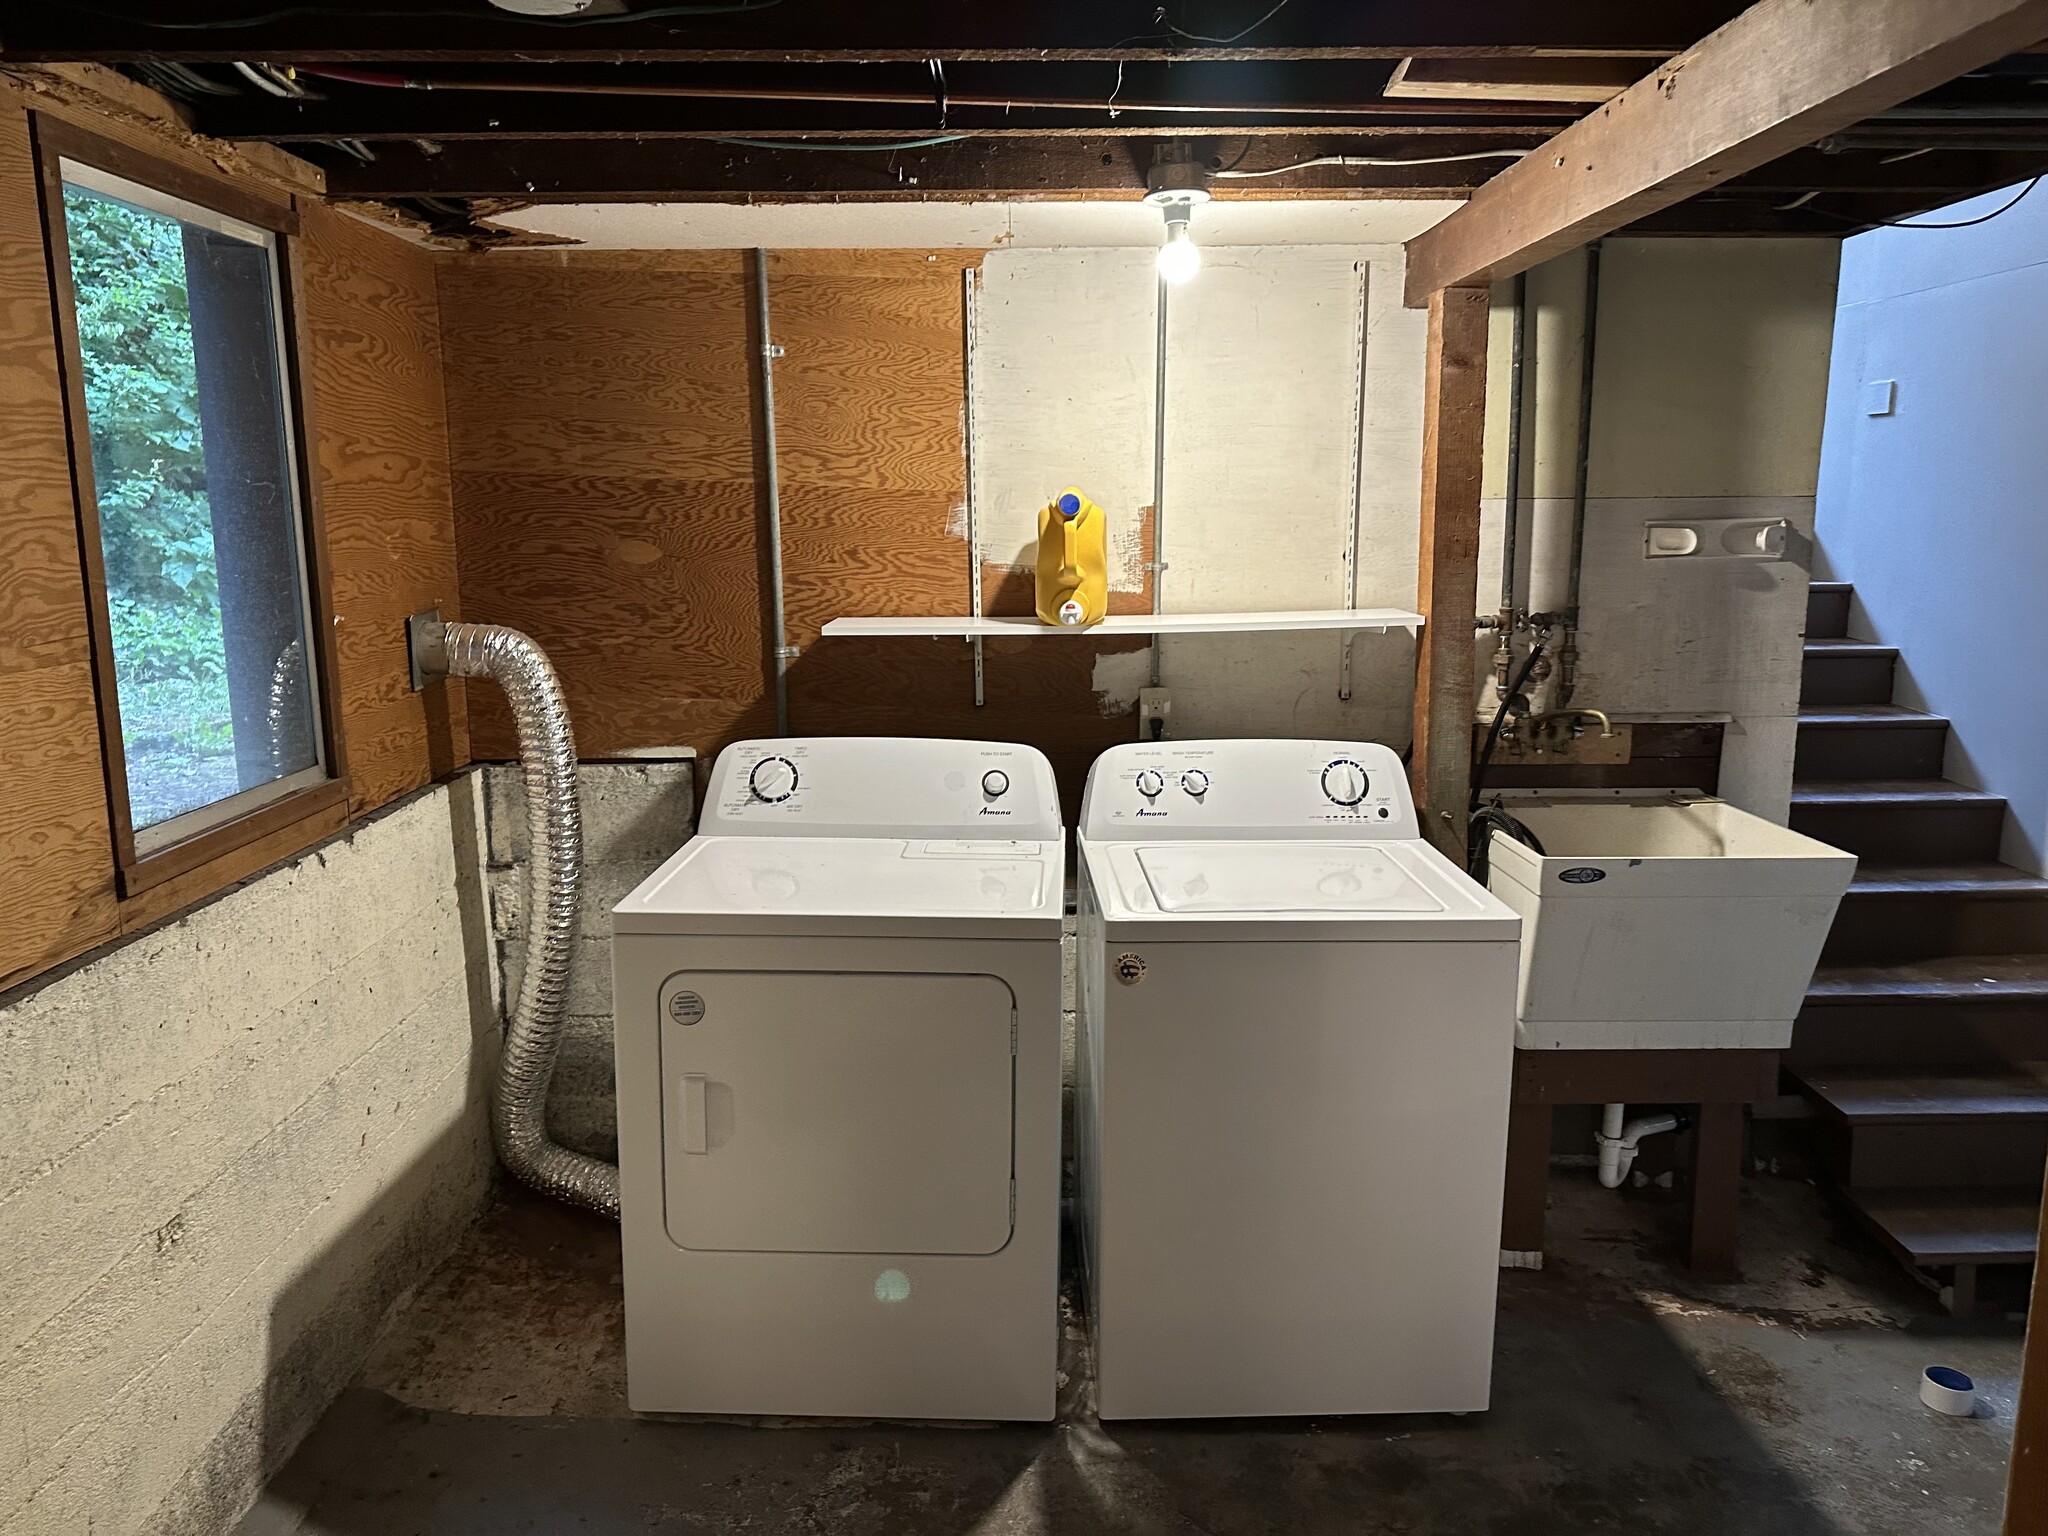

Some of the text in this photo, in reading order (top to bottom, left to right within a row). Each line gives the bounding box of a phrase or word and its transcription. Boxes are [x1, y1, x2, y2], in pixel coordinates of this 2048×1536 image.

[979, 807, 1011, 815] Amana
[1135, 808, 1168, 817] Amana
[1118, 953, 1147, 970] AMERICA
